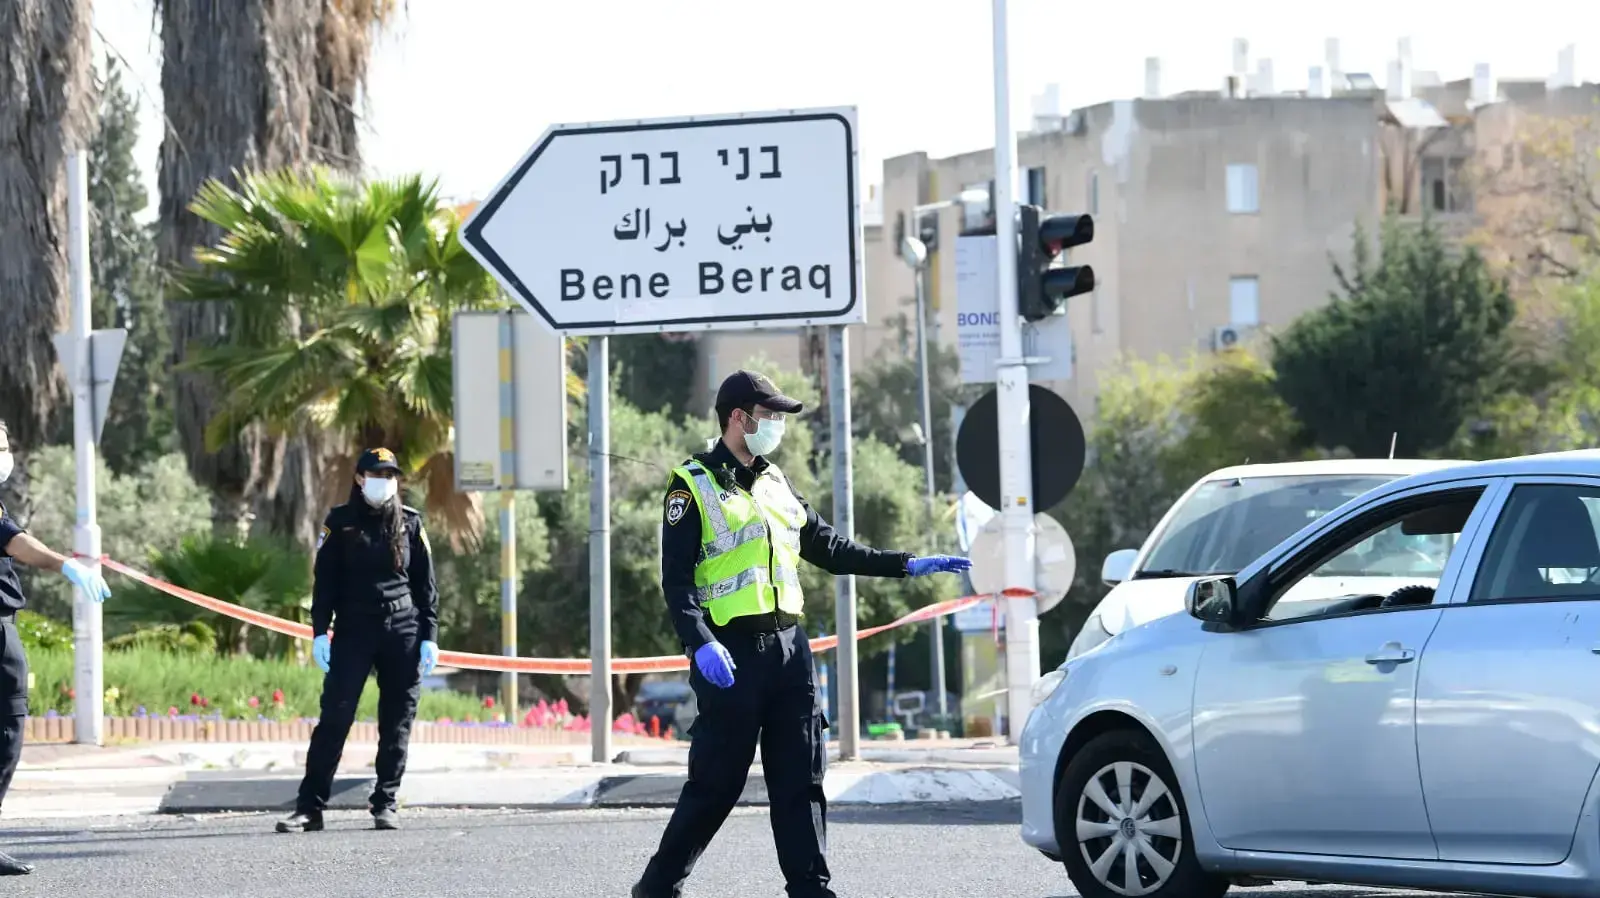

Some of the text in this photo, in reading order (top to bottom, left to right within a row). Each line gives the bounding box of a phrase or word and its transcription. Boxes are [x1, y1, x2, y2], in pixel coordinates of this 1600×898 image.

[600, 145, 782, 195] בני ברק
[613, 206, 773, 252] بني براك
[560, 261, 831, 302] Bene Beraq
